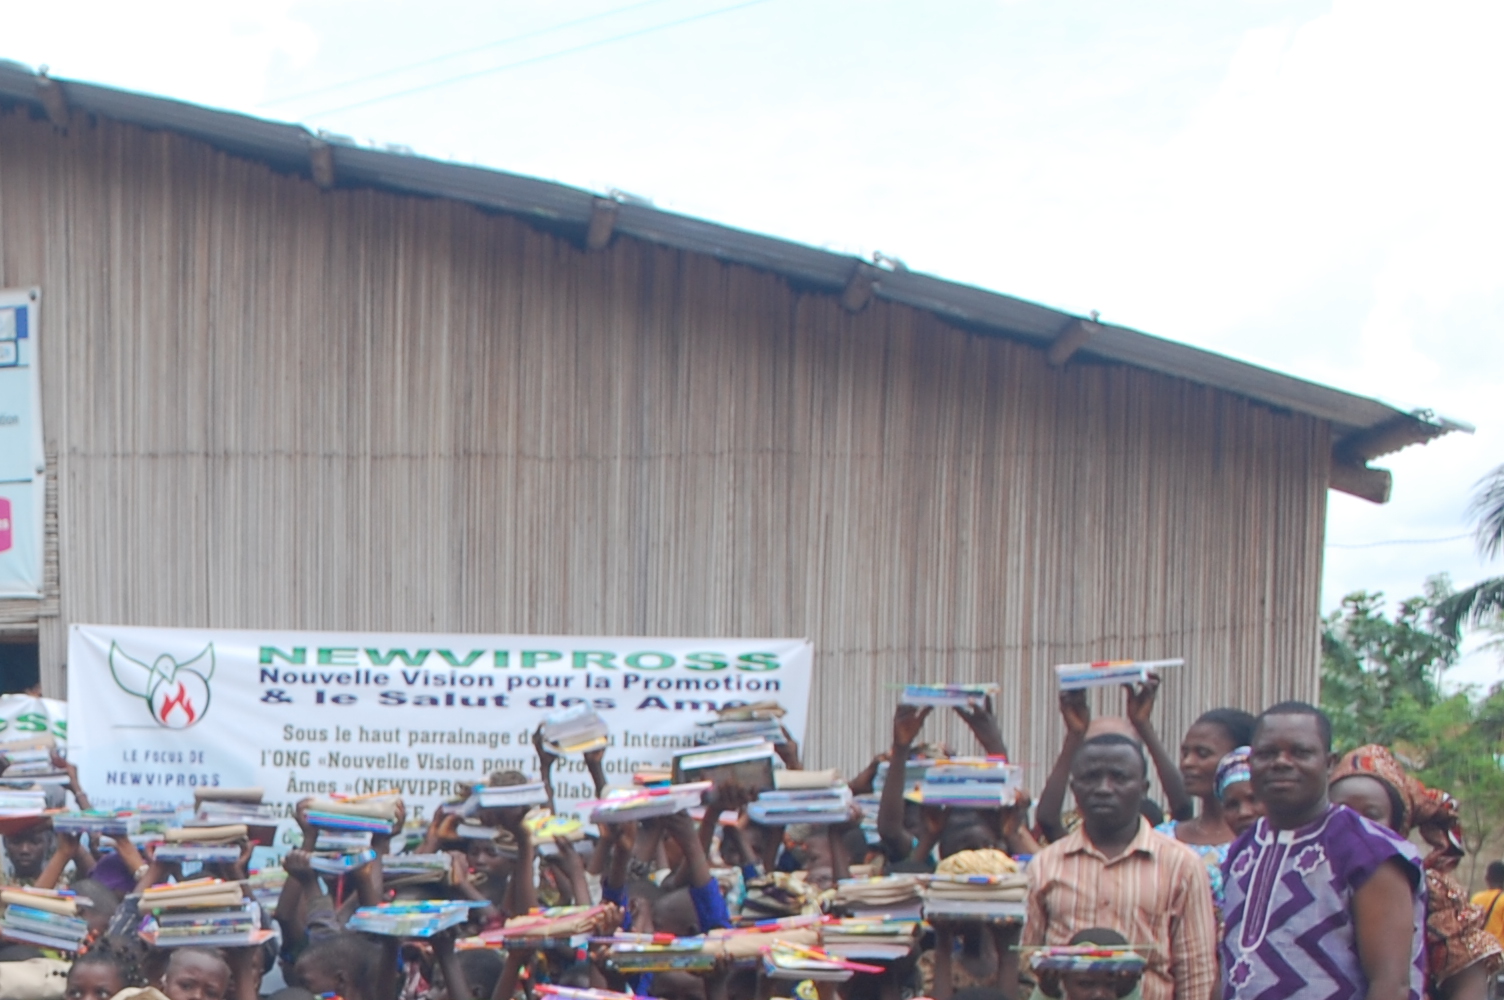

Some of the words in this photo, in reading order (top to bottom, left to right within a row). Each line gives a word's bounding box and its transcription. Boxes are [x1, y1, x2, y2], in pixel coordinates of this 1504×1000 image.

[259, 646, 781, 671] NEWVIPROSS
[259, 668, 390, 686] Nouvelle
[401, 669, 494, 688] Vision
[506, 673, 575, 692] pour
[585, 673, 611, 690] la
[623, 674, 781, 692] Promotion
[260, 688, 293, 705] &
[315, 690, 358, 705] le
[378, 690, 510, 708] Salut
[528, 693, 616, 709] des
[635, 696, 751, 711] Ame
[283, 724, 328, 742] Sous
[335, 725, 352, 743] le
[360, 725, 400, 744] haut
[408, 727, 511, 748] parrainage
[123, 750, 137, 763] LE
[145, 750, 183, 763] FOCUS
[190, 750, 205, 764] DE
[261, 750, 311, 767] l'ONG
[417, 753, 474, 771] Vision
[482, 756, 529, 774] pour
[556, 755, 648, 774] Prootio
[107, 771, 221, 787] NEWVIPROSS
[287, 771, 337, 794] Âmes
